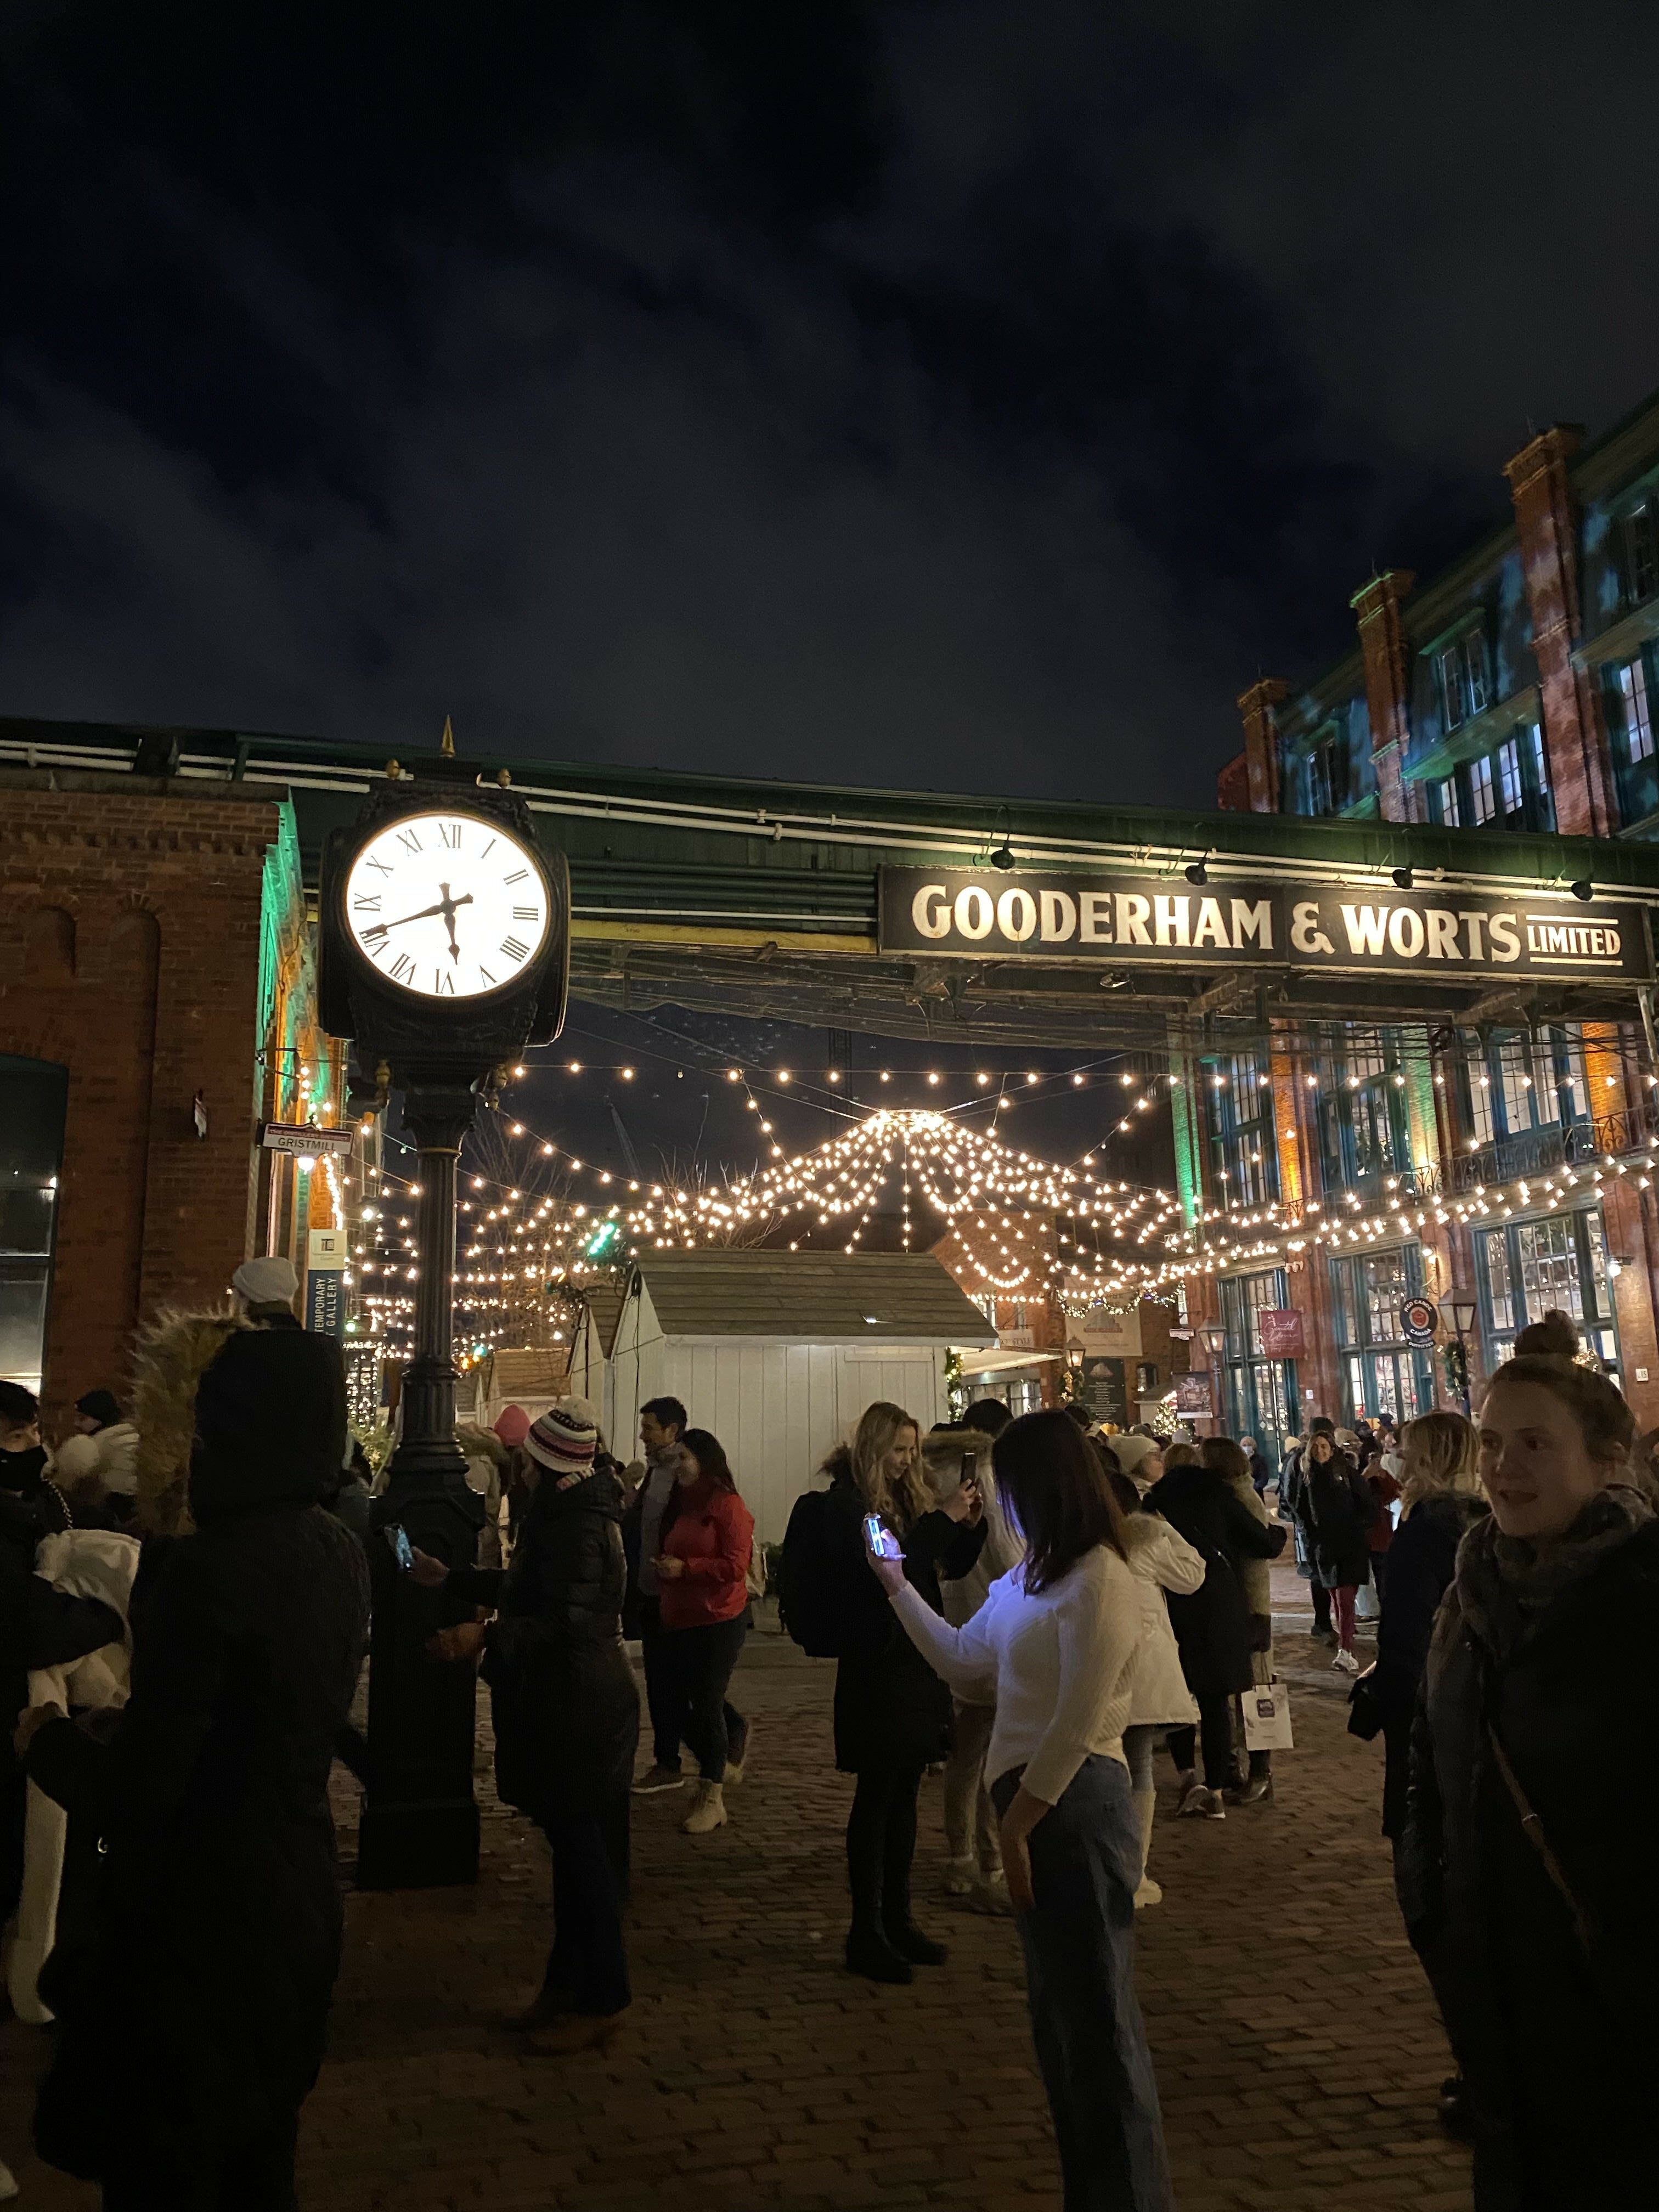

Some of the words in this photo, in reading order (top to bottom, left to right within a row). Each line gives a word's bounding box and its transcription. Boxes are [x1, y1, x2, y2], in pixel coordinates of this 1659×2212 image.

[396, 829, 423, 856] XI
[438, 823, 461, 848] XII
[480, 838, 496, 859] I
[365, 856, 394, 878] X
[503, 869, 529, 885] II
[354, 893, 381, 911] IX
[513, 906, 539, 921] III
[912, 884, 1274, 950] GOODERHAM
[1291, 901, 1336, 954] &
[1340, 904, 1521, 963] WORTS
[1527, 925, 1621, 955] LIMITED
[499, 935, 531, 962] IIII
[388, 953, 416, 985] VII
[479, 965, 497, 988] V
[435, 969, 455, 994] VI
[278, 1137, 336, 1150] GRISTMILL
[326, 1278, 337, 1327] GALLERY
[1404, 1301, 1414, 1312] RED
